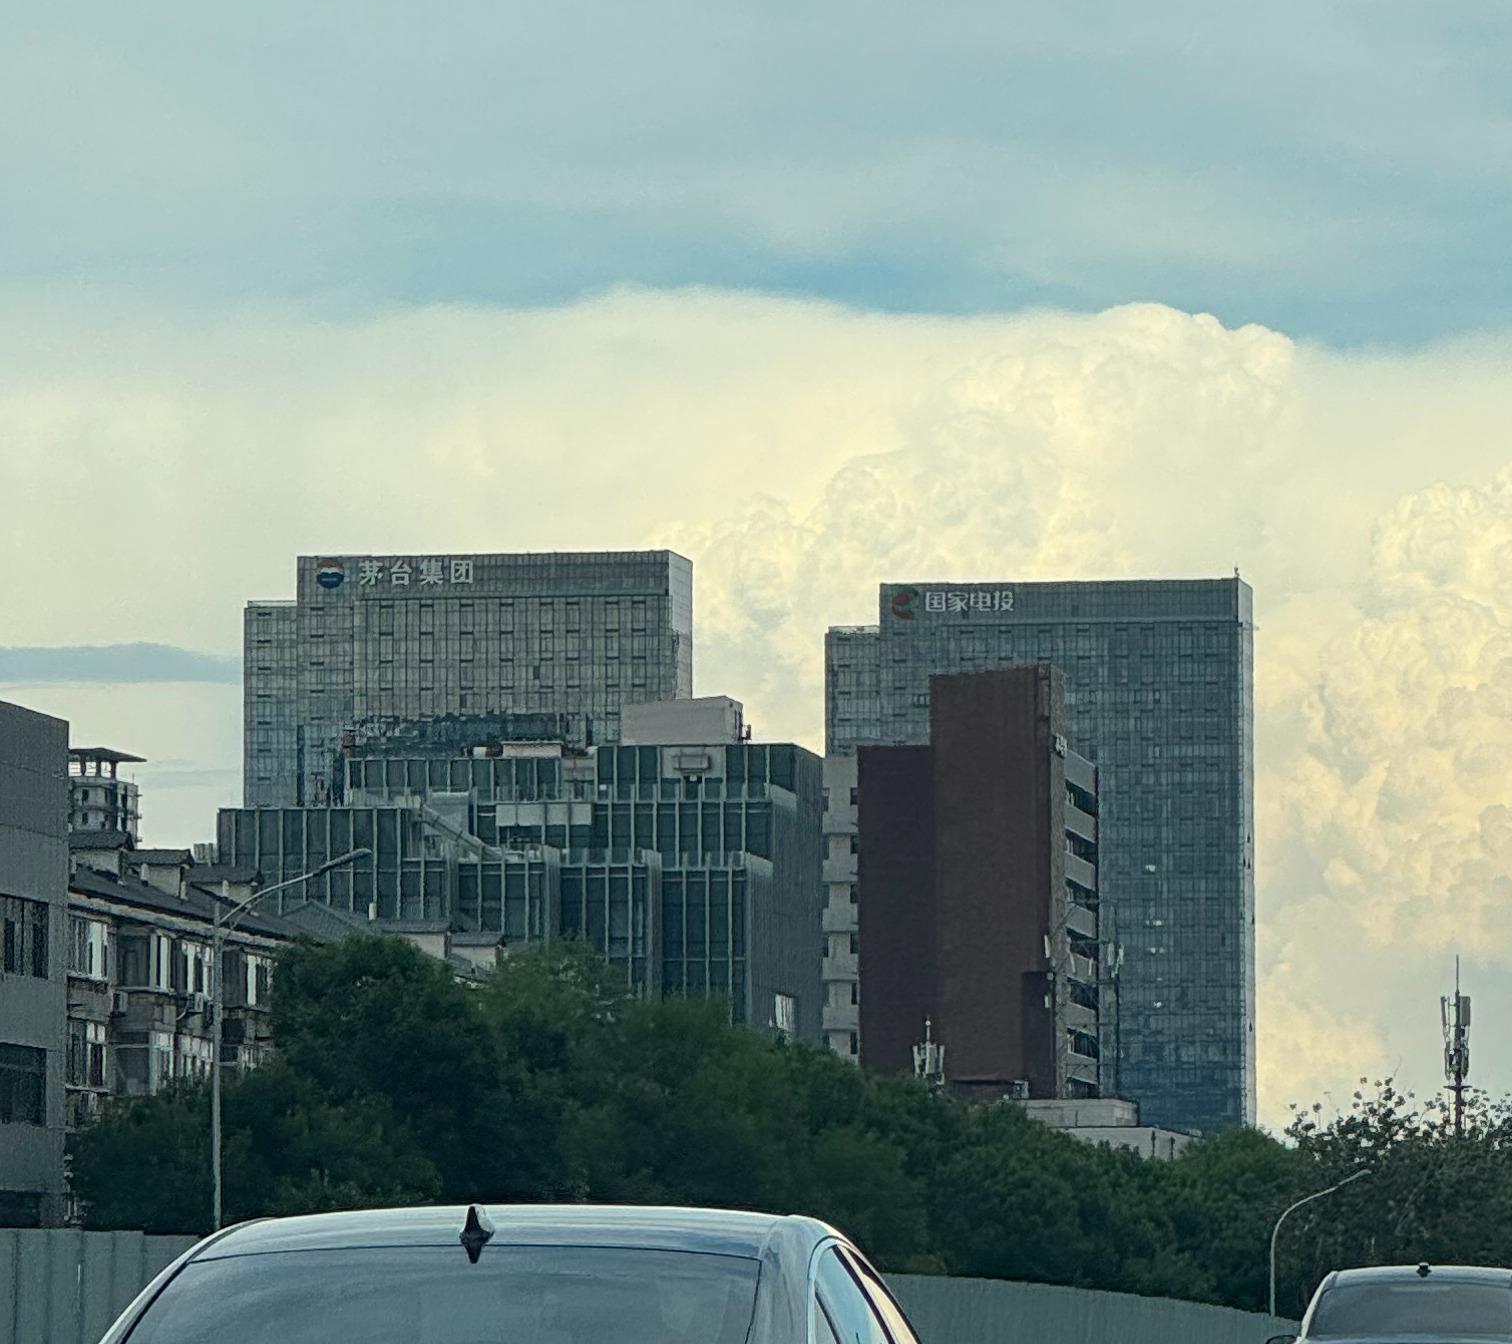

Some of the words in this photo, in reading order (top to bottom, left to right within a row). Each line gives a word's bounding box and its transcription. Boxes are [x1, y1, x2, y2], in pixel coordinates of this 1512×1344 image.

[359, 559, 474, 586] 茅台集团
[925, 591, 1014, 613] 国家电投
